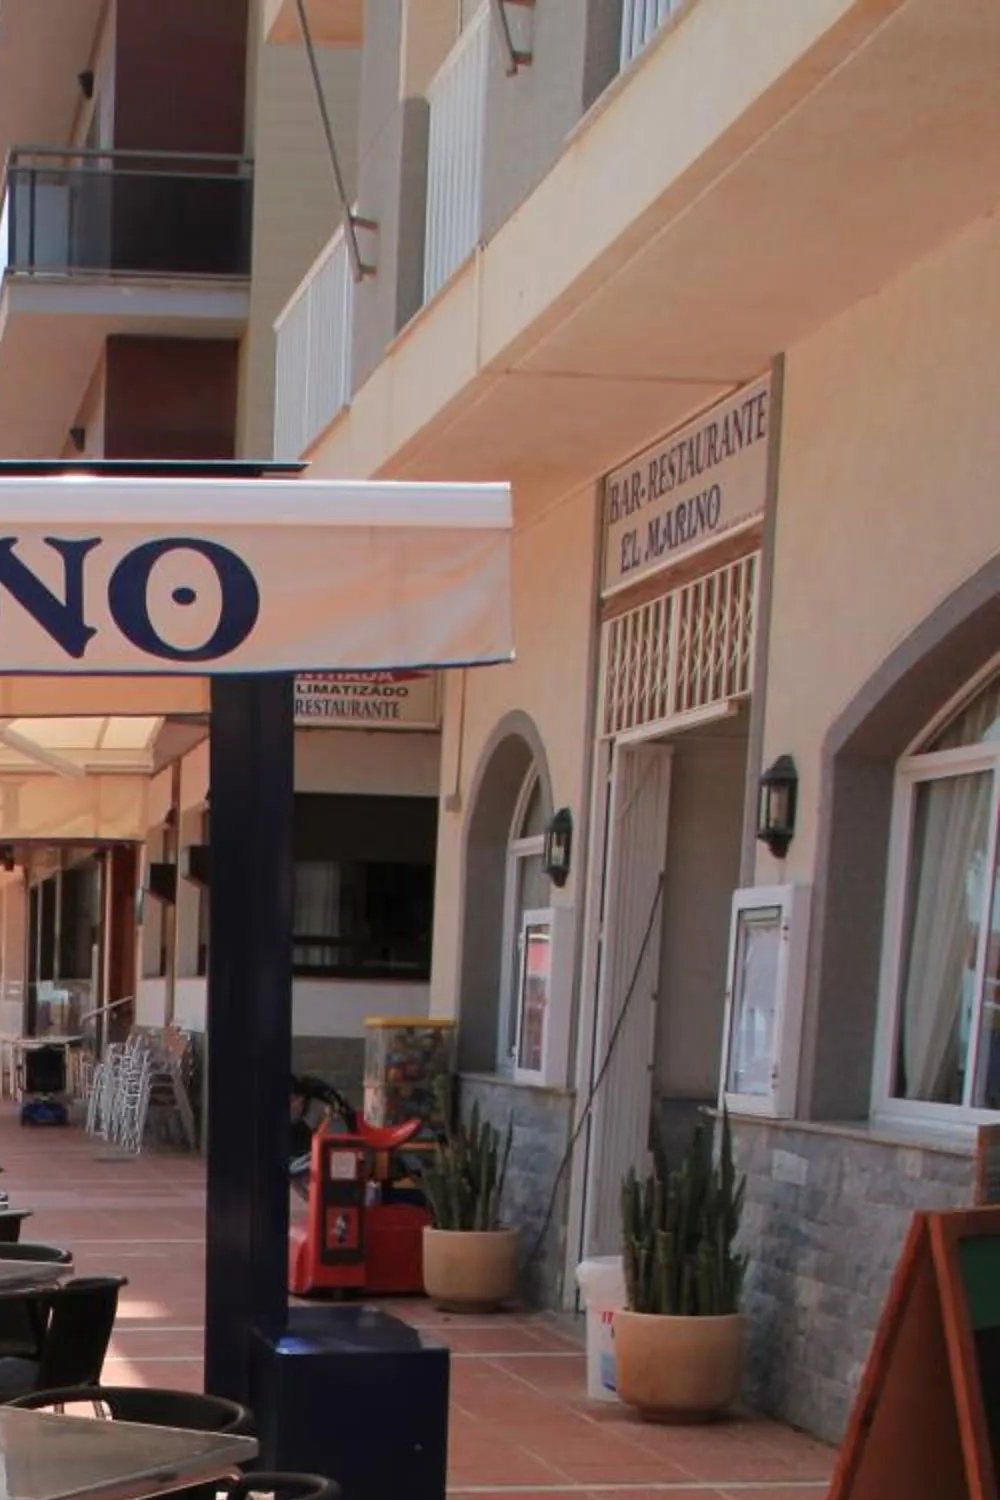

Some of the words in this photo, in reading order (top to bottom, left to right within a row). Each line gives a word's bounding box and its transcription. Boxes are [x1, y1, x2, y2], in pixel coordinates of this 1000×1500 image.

[620, 529, 641, 575] EL
[644, 483, 722, 562] MARINO
[294, 699, 400, 718] RESTAURANTE
